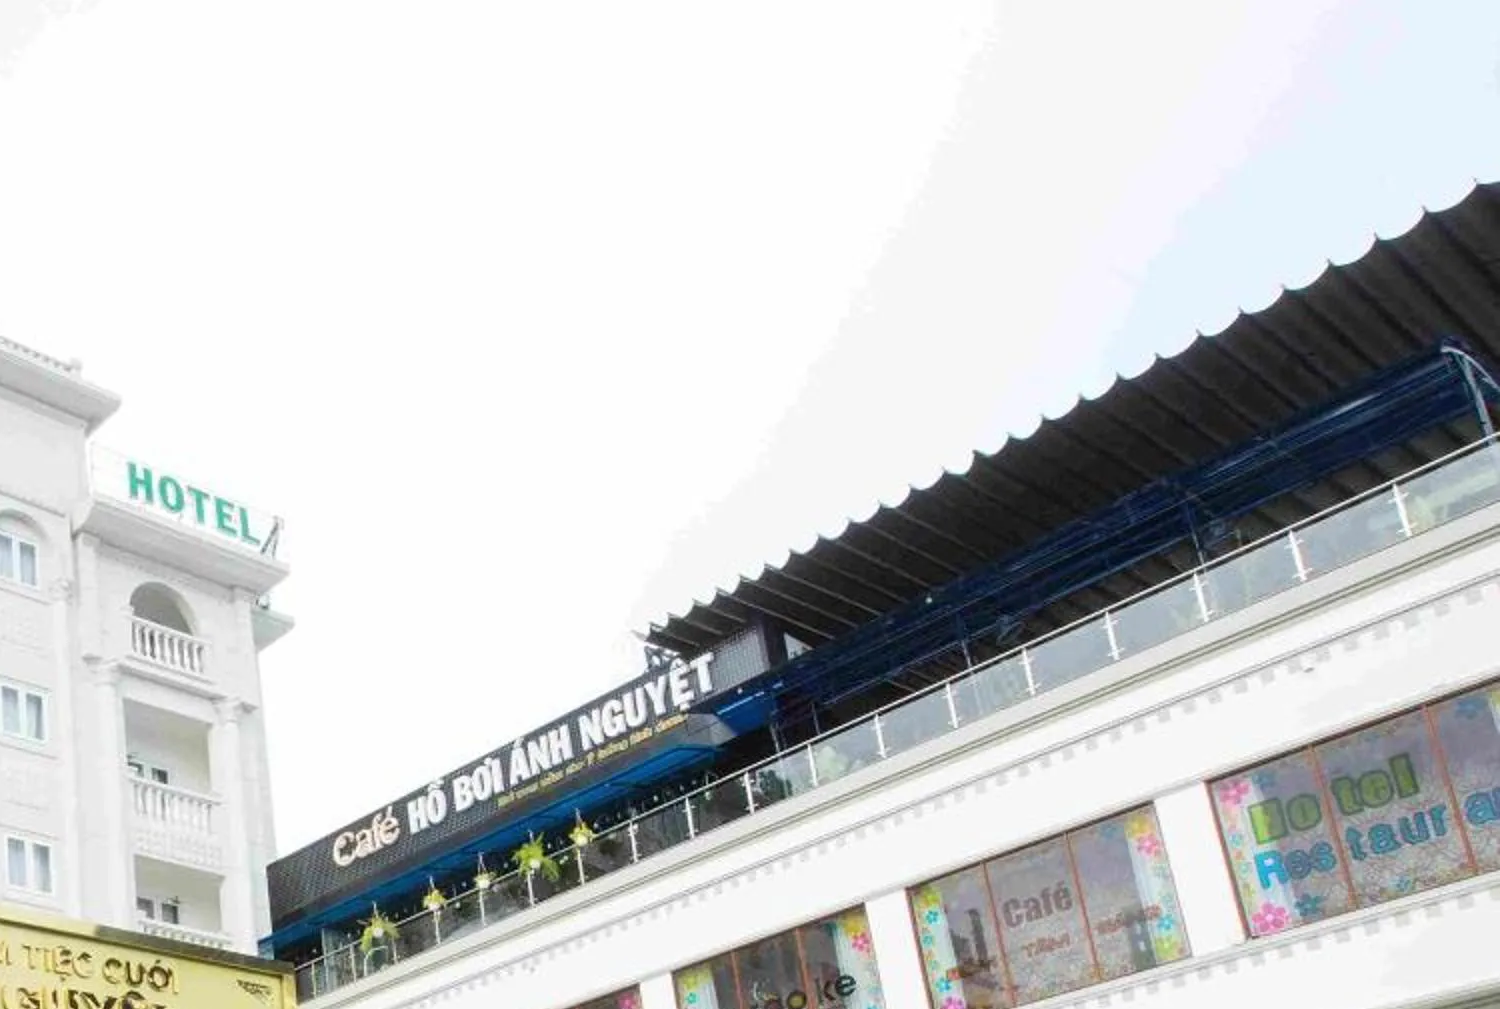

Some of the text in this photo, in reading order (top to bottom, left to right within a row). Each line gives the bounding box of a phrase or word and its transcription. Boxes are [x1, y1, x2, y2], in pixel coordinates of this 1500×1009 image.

[126, 460, 261, 547] HOTEL
[332, 806, 401, 867] Café
[406, 778, 448, 836] HỒ
[508, 733, 576, 788] ÁNH
[577, 651, 715, 751] NGUYỆT
[1003, 879, 1074, 930] Café
